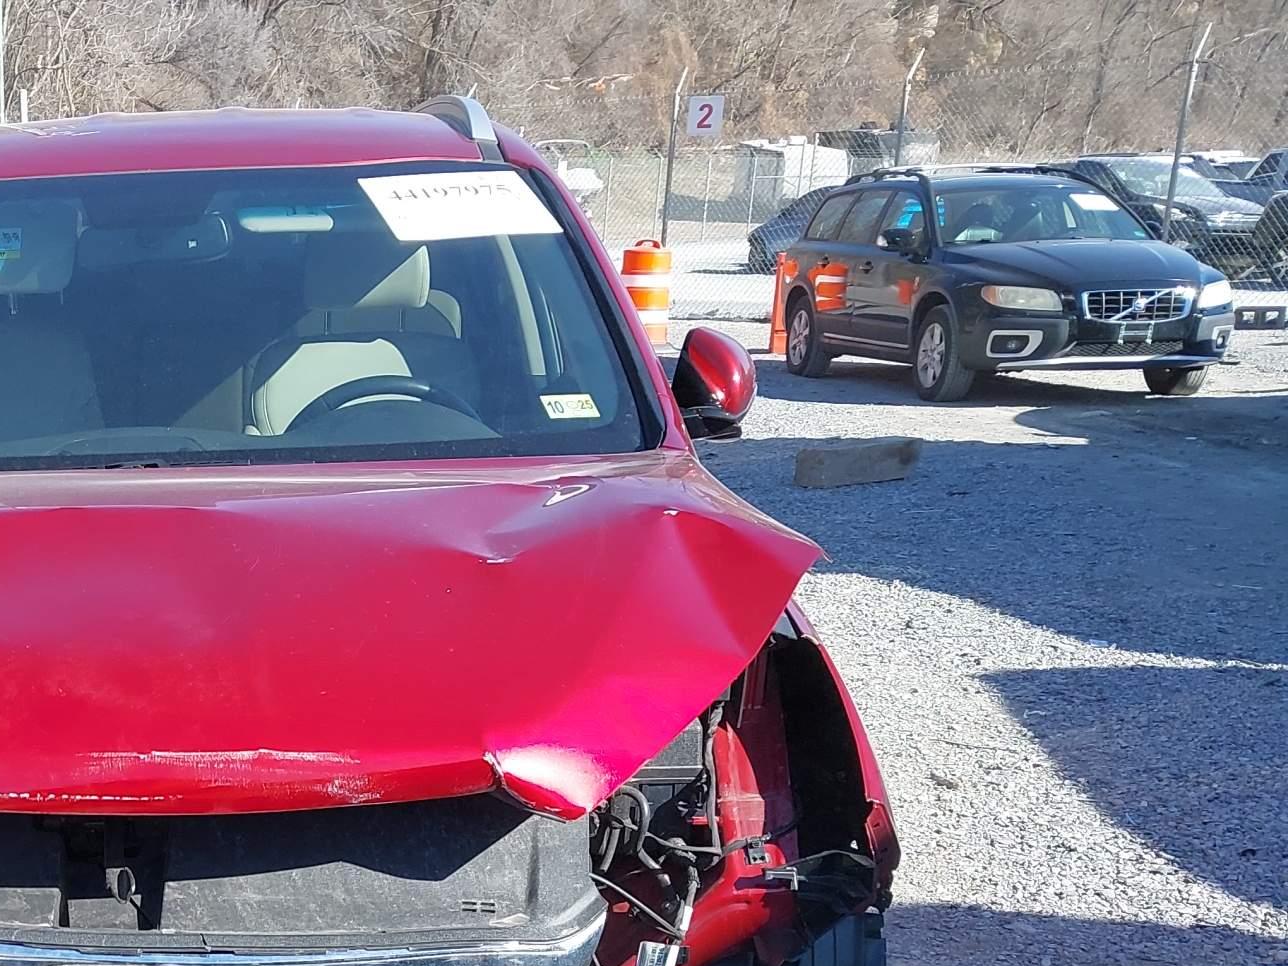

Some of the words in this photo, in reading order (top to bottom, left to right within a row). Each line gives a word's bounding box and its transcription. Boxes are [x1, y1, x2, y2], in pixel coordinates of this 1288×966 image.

[696, 103, 713, 129] 2
[389, 184, 514, 201] 44197975
[546, 400, 565, 414] 10
[577, 399, 594, 410] 25
